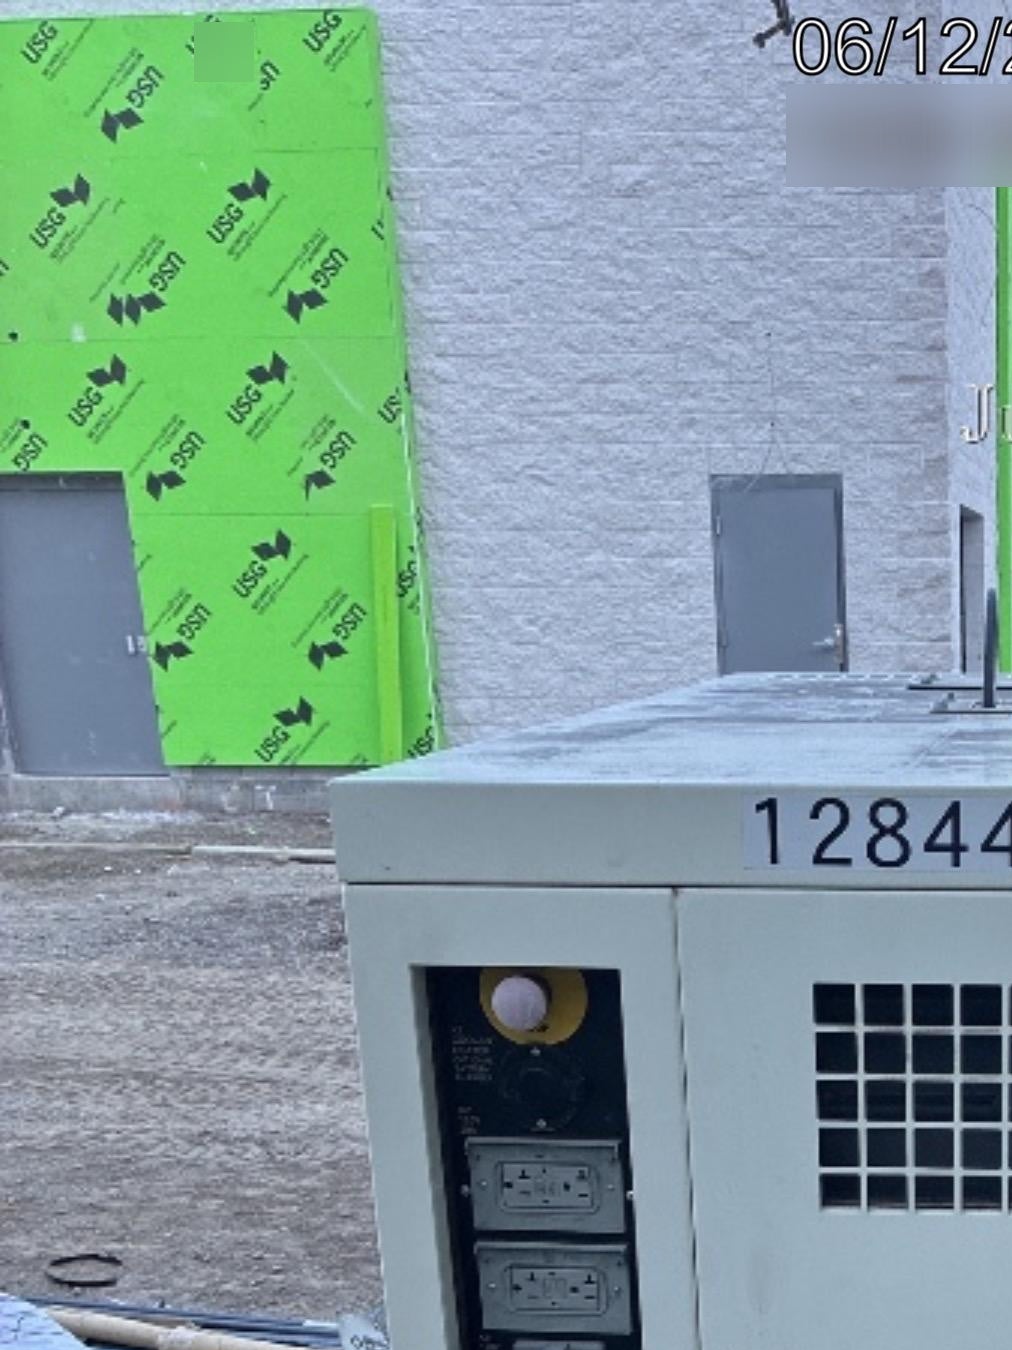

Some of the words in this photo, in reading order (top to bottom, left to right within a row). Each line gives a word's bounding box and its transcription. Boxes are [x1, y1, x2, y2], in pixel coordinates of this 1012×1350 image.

[20, 21, 58, 64] USG
[302, 10, 342, 53] USG
[126, 65, 165, 108] USG
[29, 206, 66, 249] USG
[206, 203, 244, 244] USG
[149, 251, 187, 292] USG
[310, 248, 349, 289] USG
[67, 386, 104, 427] USG
[225, 384, 262, 425] USG
[11, 432, 48, 472] USG
[170, 431, 206, 470] USG
[319, 431, 357, 469] USG
[231, 560, 268, 598] USG
[177, 602, 212, 640] USG
[332, 602, 367, 640] USG
[254, 725, 291, 763] USG
